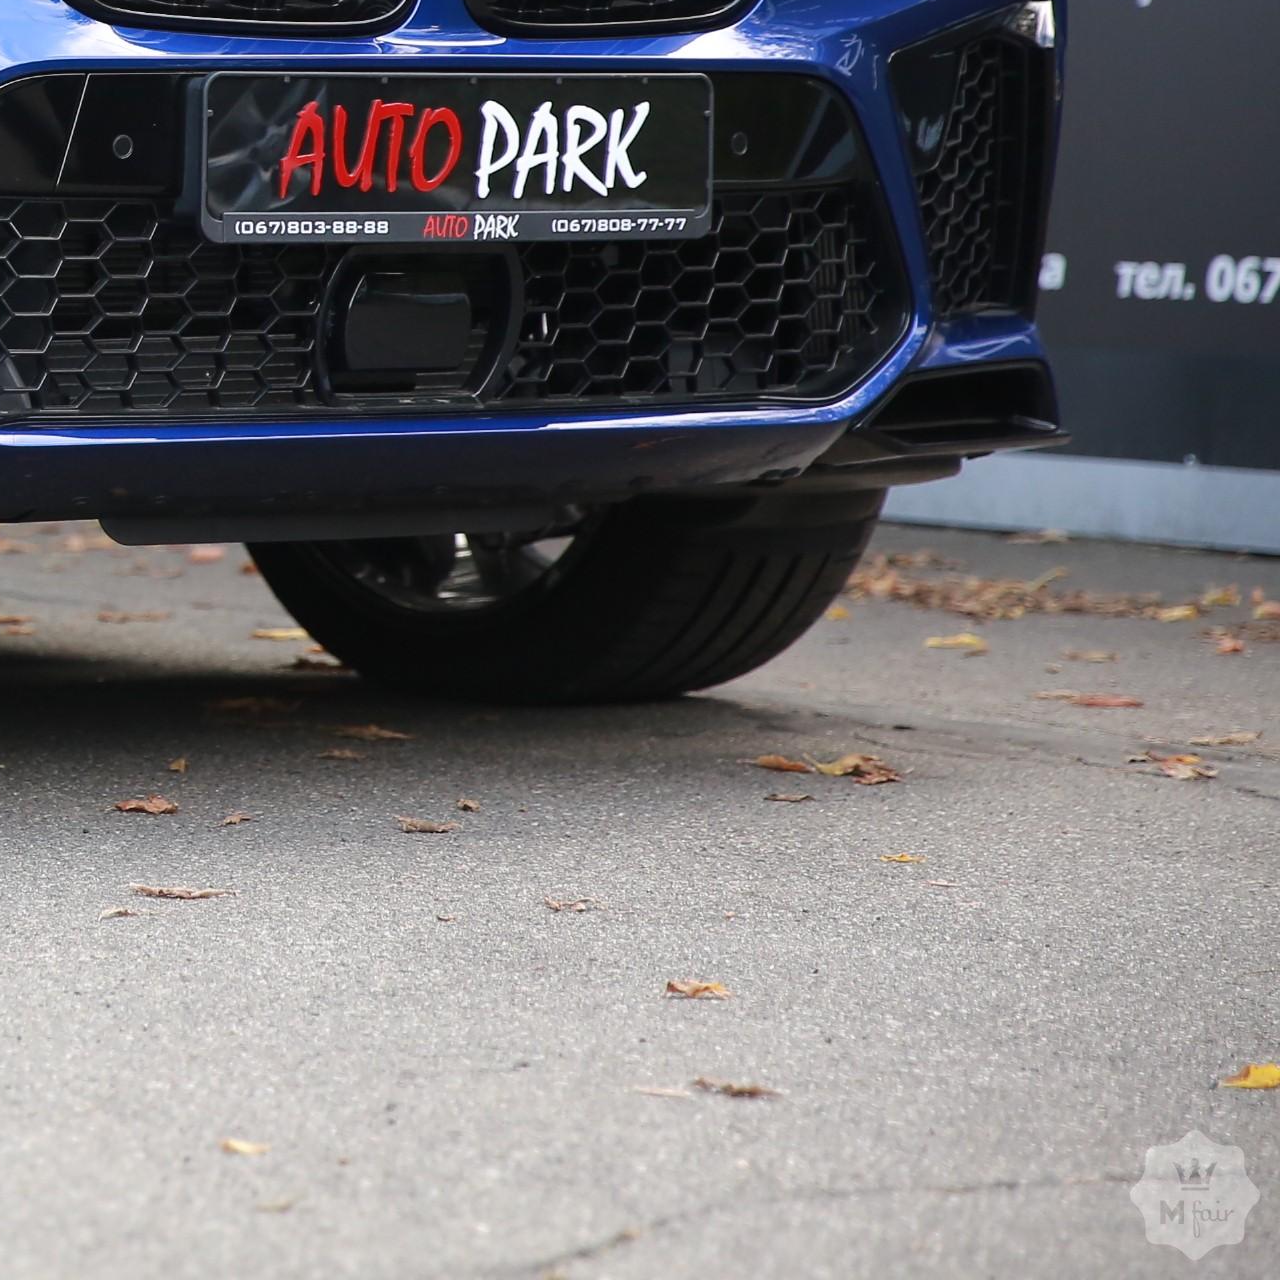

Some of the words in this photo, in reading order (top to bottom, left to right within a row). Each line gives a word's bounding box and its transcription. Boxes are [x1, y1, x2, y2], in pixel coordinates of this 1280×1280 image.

[280, 99, 462, 200] AUTO
[474, 99, 650, 199] PARK
[234, 220, 389, 235] (067)803-88-88
[423, 214, 468, 239] AUTO
[472, 213, 519, 240] PARK
[551, 217, 687, 233] (067)808-77-77
[1114, 260, 1195, 301] тел.
